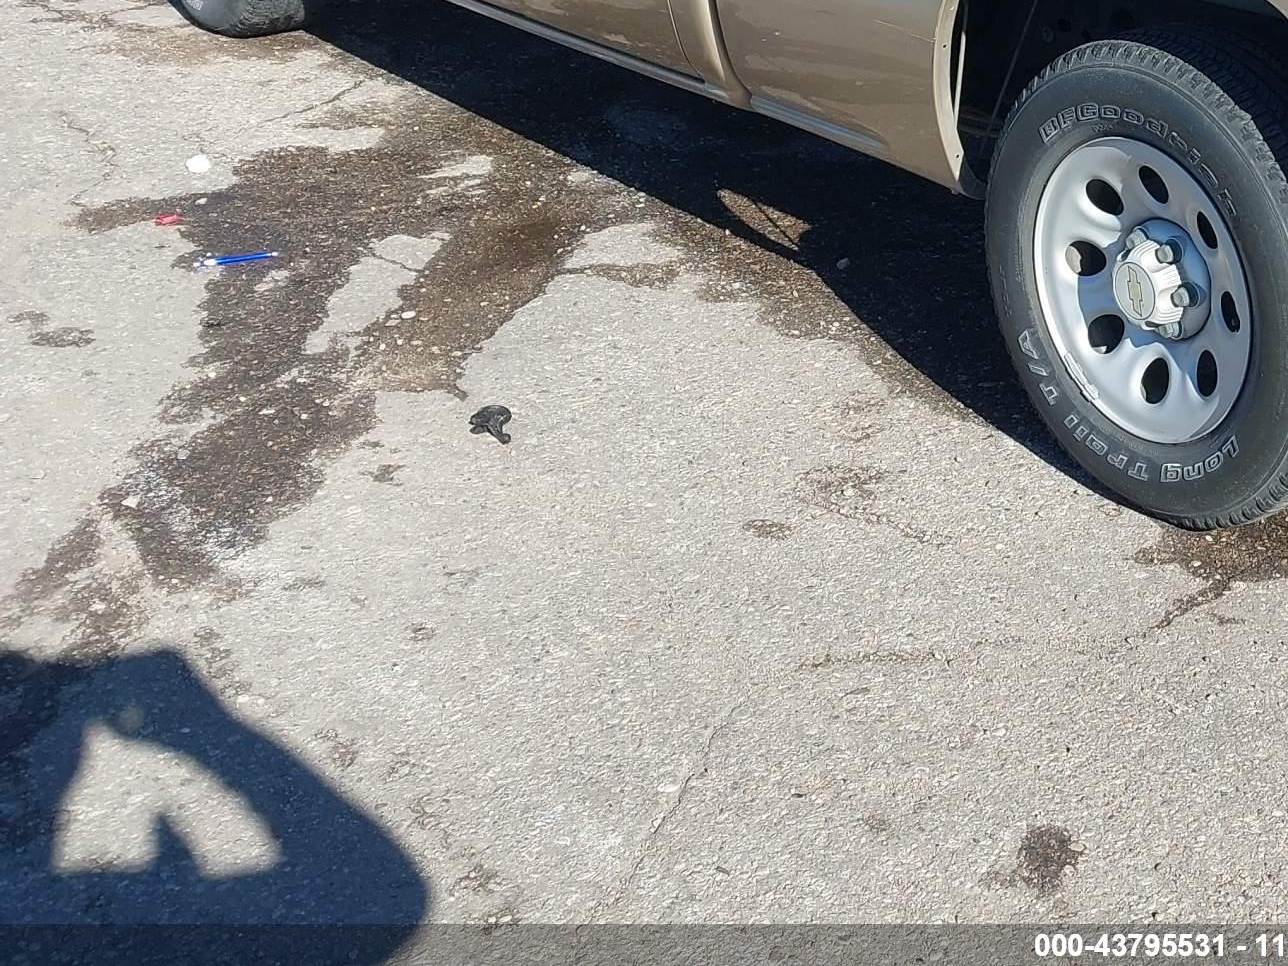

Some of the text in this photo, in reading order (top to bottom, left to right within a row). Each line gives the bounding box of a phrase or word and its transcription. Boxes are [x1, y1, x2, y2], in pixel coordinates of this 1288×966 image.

[1038, 103, 1238, 219] BFGoodrich
[1017, 328, 1060, 406] T/A
[1063, 412, 1149, 482] Trail
[1159, 434, 1240, 483] Long
